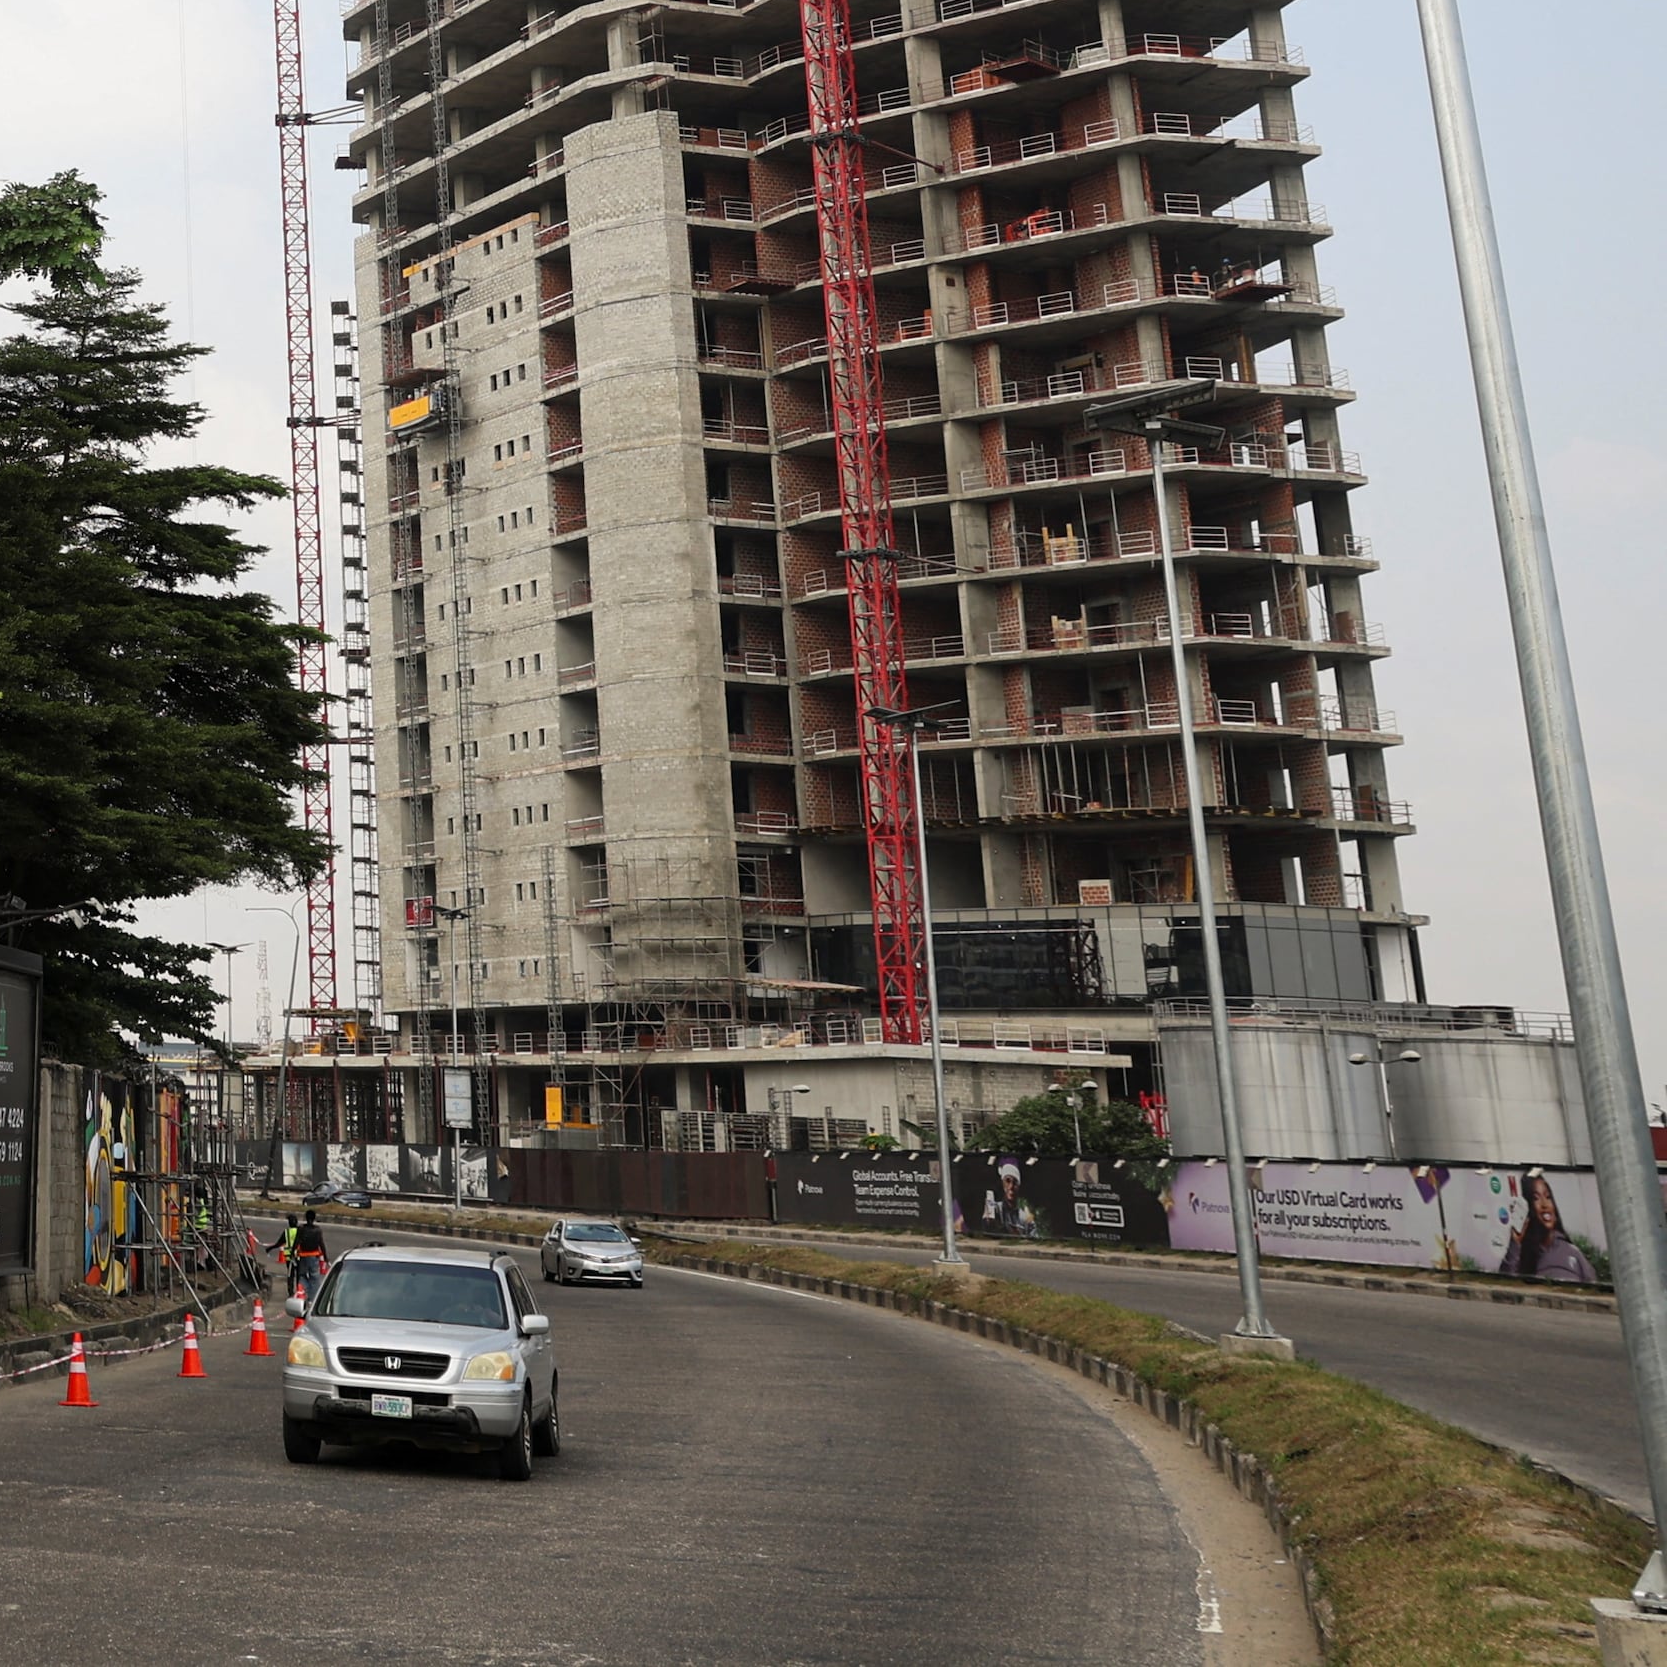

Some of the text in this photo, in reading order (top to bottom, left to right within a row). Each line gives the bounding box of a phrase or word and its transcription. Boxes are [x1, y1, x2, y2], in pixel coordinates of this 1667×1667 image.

[7, 1107, 24, 1129] 4224
[8, 1141, 23, 1162] 1124
[1256, 1189, 1404, 1211] Our USD Virtual Card works
[1257, 1208, 1391, 1233] for all your subscriptions.
